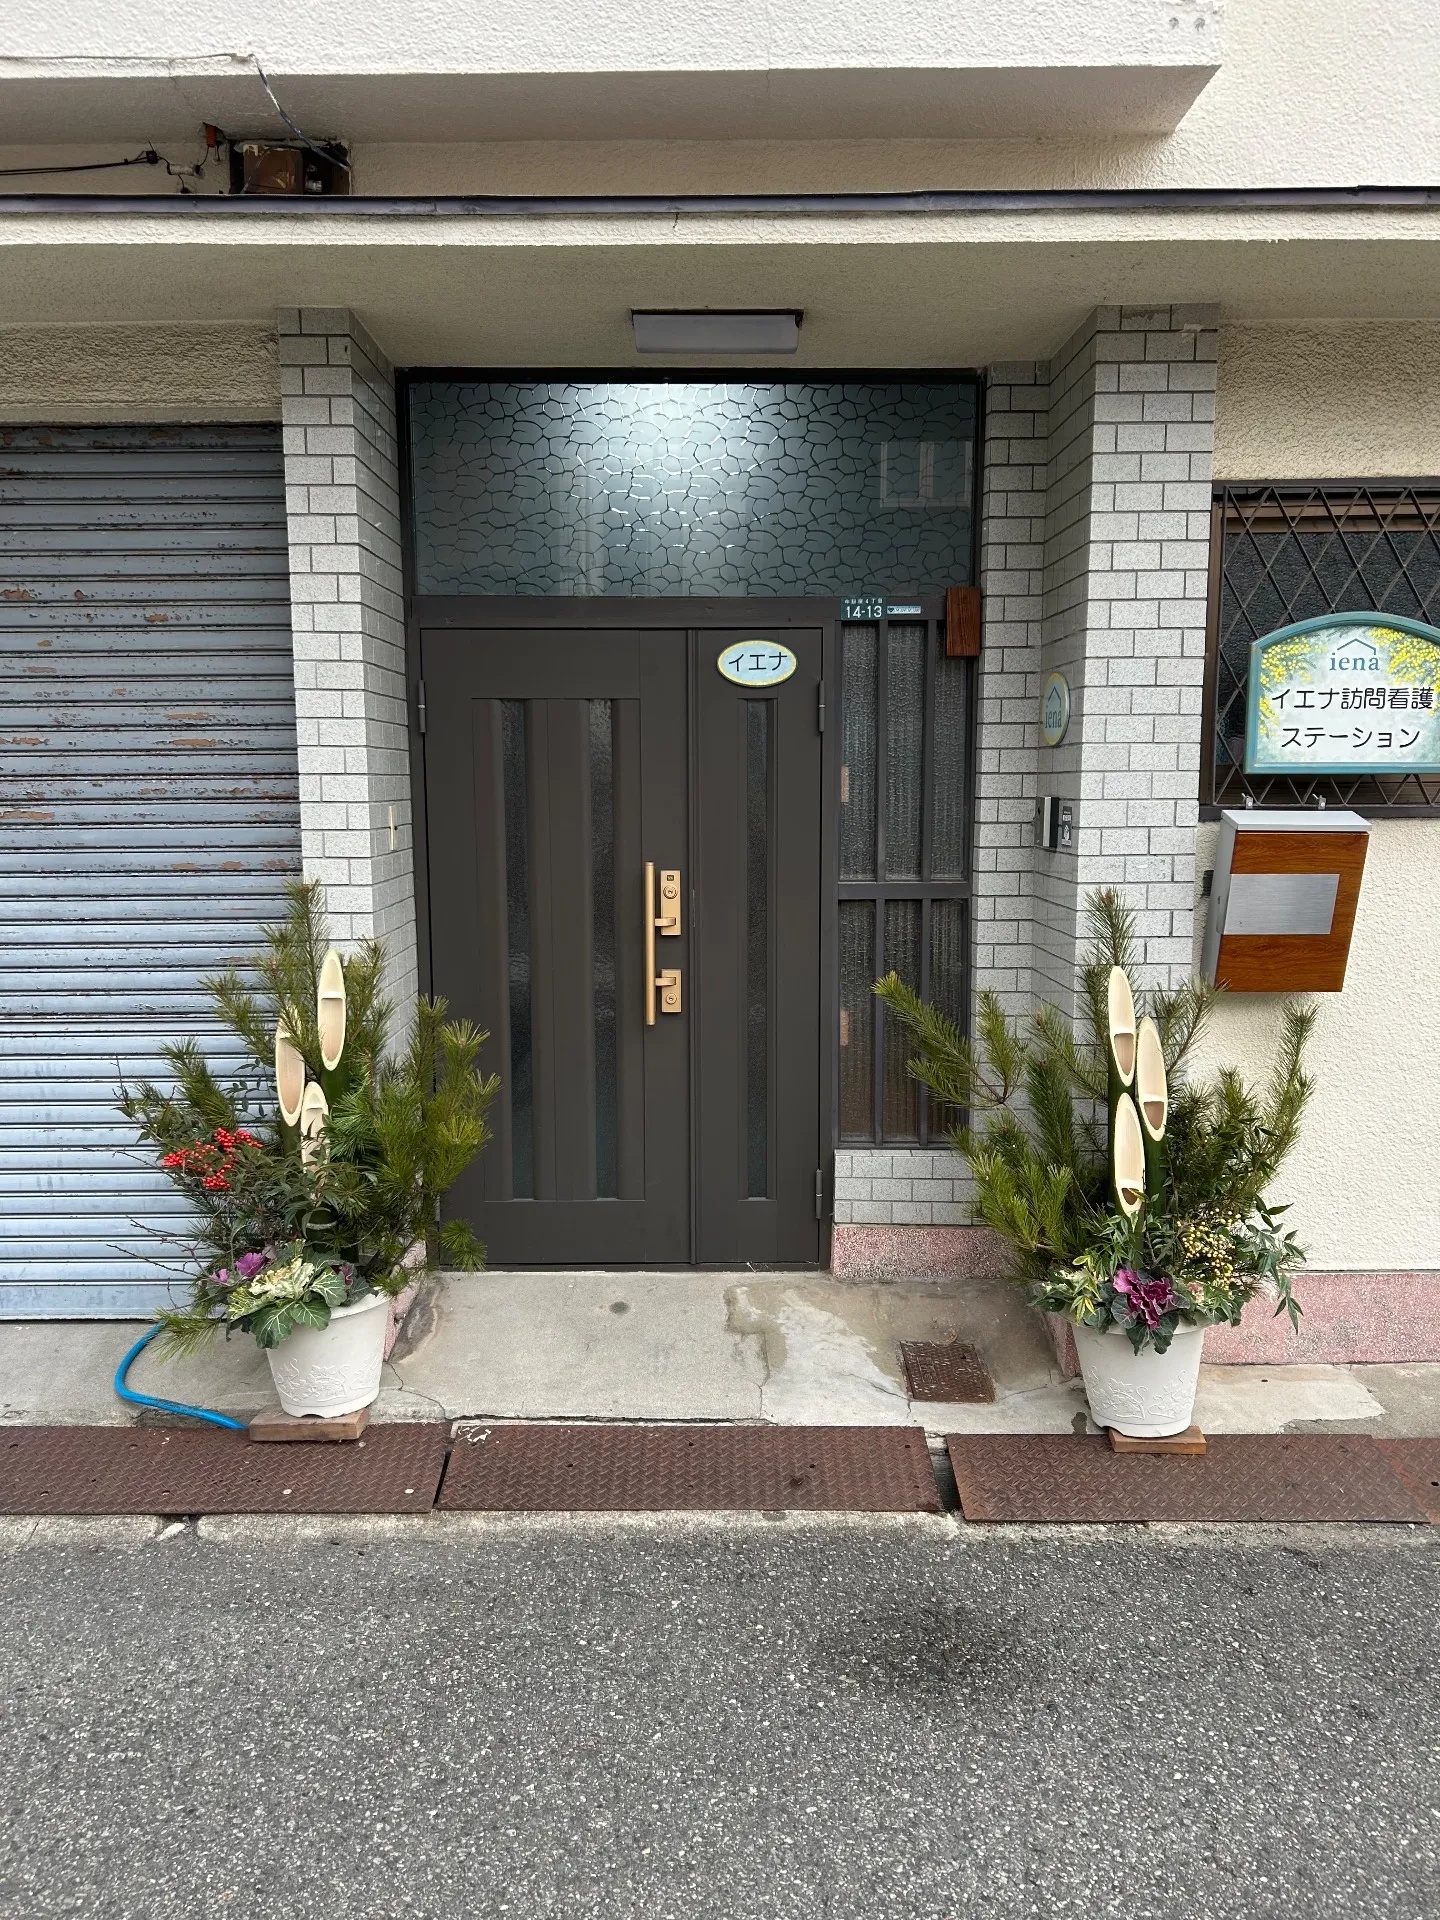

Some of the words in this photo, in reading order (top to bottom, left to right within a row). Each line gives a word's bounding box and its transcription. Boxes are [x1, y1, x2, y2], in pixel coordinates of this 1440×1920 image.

[846, 605, 882, 618] 14-13
[728, 651, 788, 672] イエナ
[1329, 652, 1380, 671] iena
[1271, 687, 1434, 710] イエナ訪問看護
[1044, 704, 1062, 729] iena
[1281, 727, 1421, 748] ステーション
